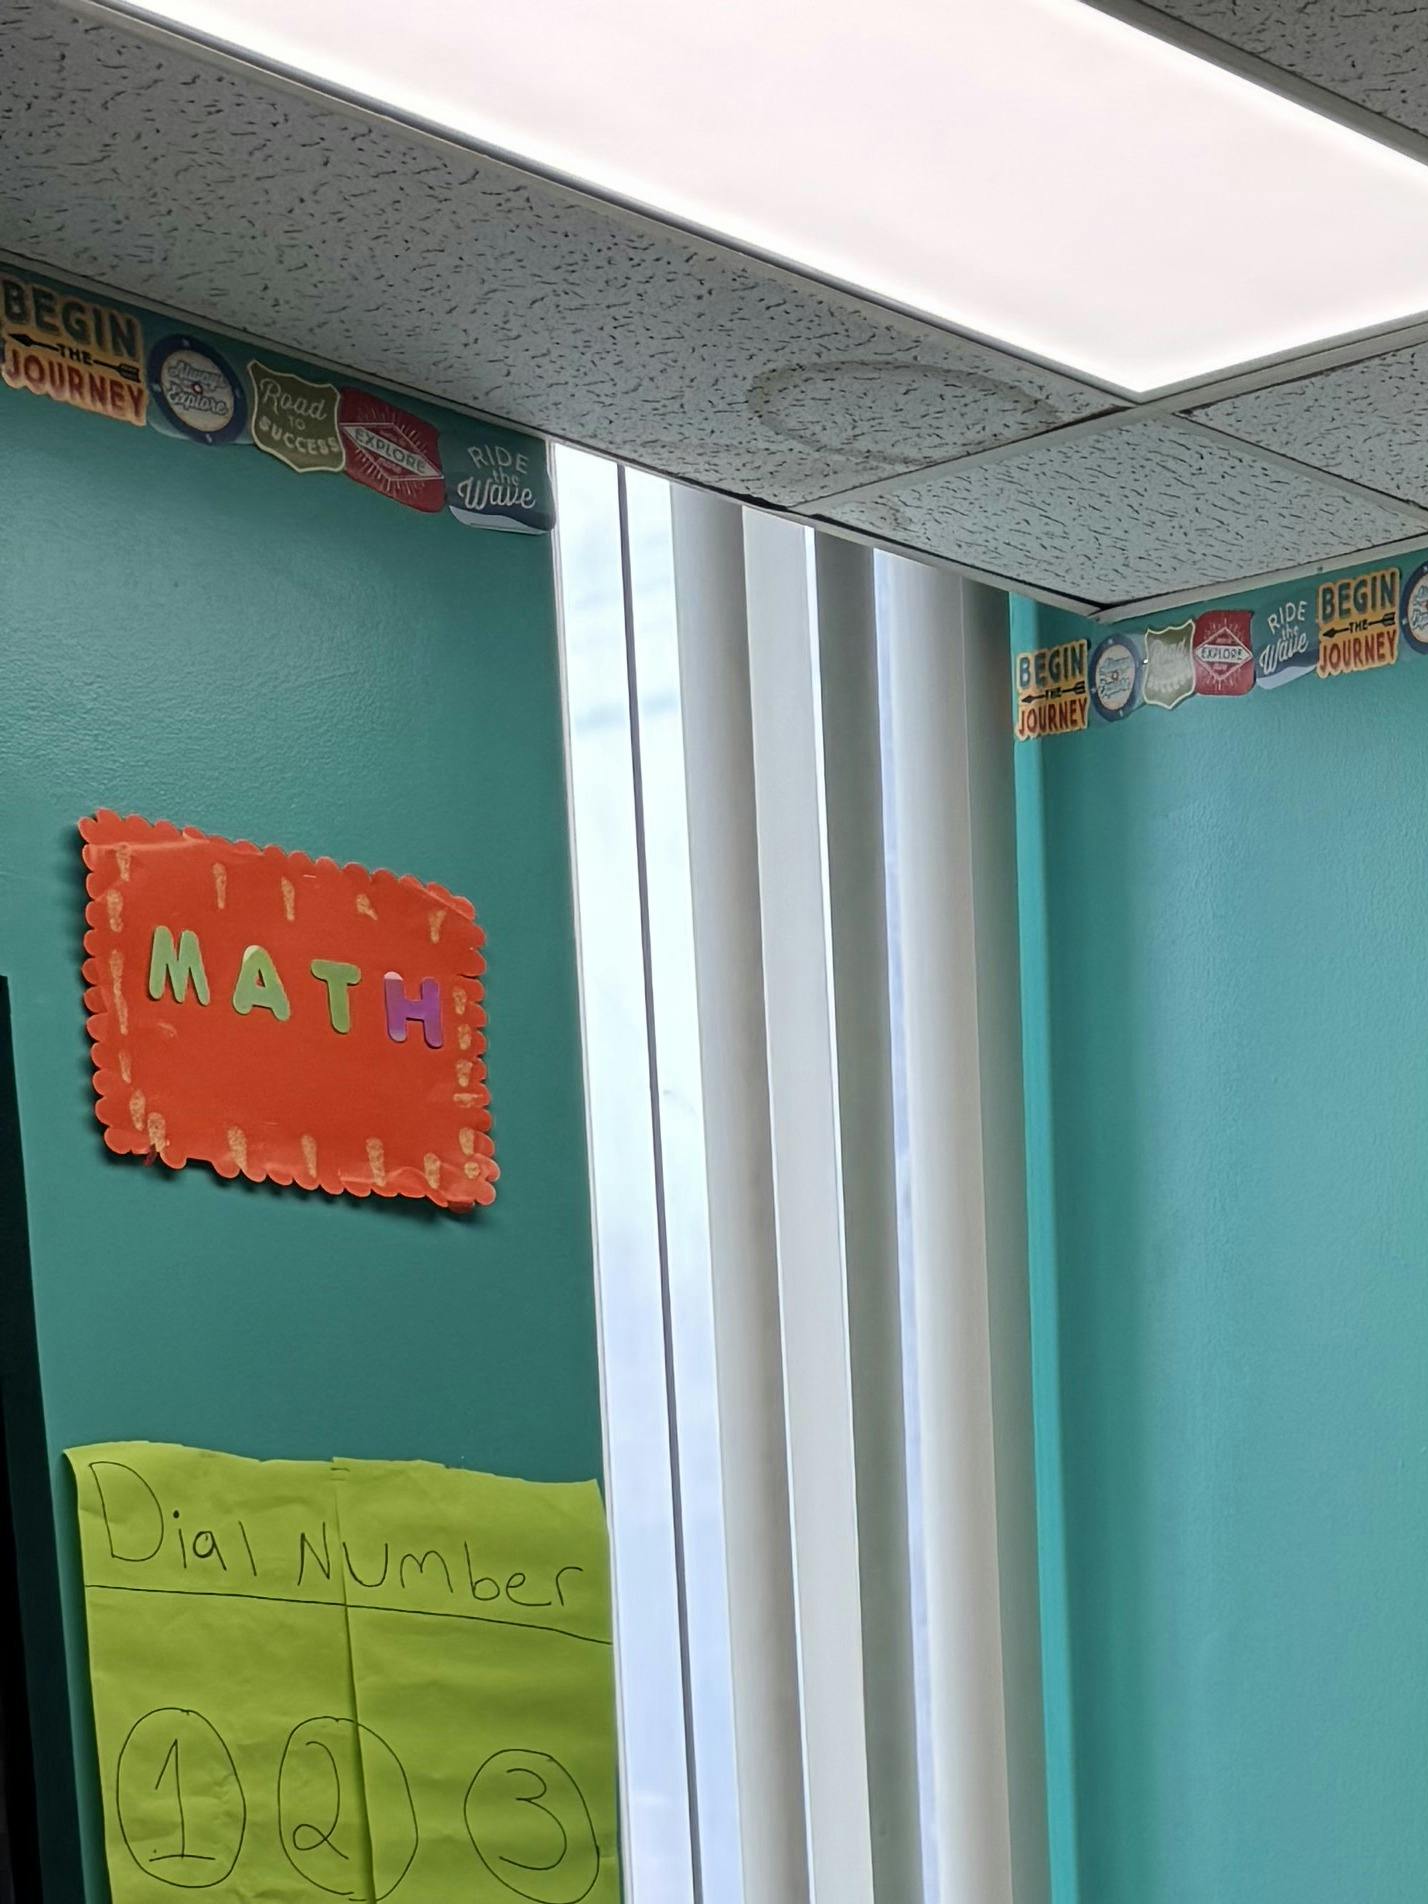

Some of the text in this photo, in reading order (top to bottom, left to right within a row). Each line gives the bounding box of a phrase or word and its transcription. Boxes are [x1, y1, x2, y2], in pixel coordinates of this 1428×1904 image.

[3, 279, 138, 358] BEGIN
[58, 344, 93, 365] THE
[7, 350, 145, 417] JOURNEY
[167, 383, 229, 416] Explore
[259, 377, 327, 421] Road
[258, 415, 341, 456] SUCCESS
[287, 414, 306, 431] TO
[355, 430, 427, 475] EXPLORE
[468, 444, 529, 475] RIDE
[457, 476, 536, 509] Wave
[491, 469, 519, 488] the
[1267, 601, 1307, 634] RIDE
[1322, 572, 1395, 622] BEGIN
[1019, 643, 1085, 689] BEGIN
[1259, 633, 1308, 675] Wave
[1320, 630, 1396, 673] JOURNEY
[1019, 697, 1088, 734] JOURNEY
[148, 926, 445, 1051] MATH
[89, 1461, 584, 1608] Dial Number
[148, 1738, 568, 1871] 1 2 3
